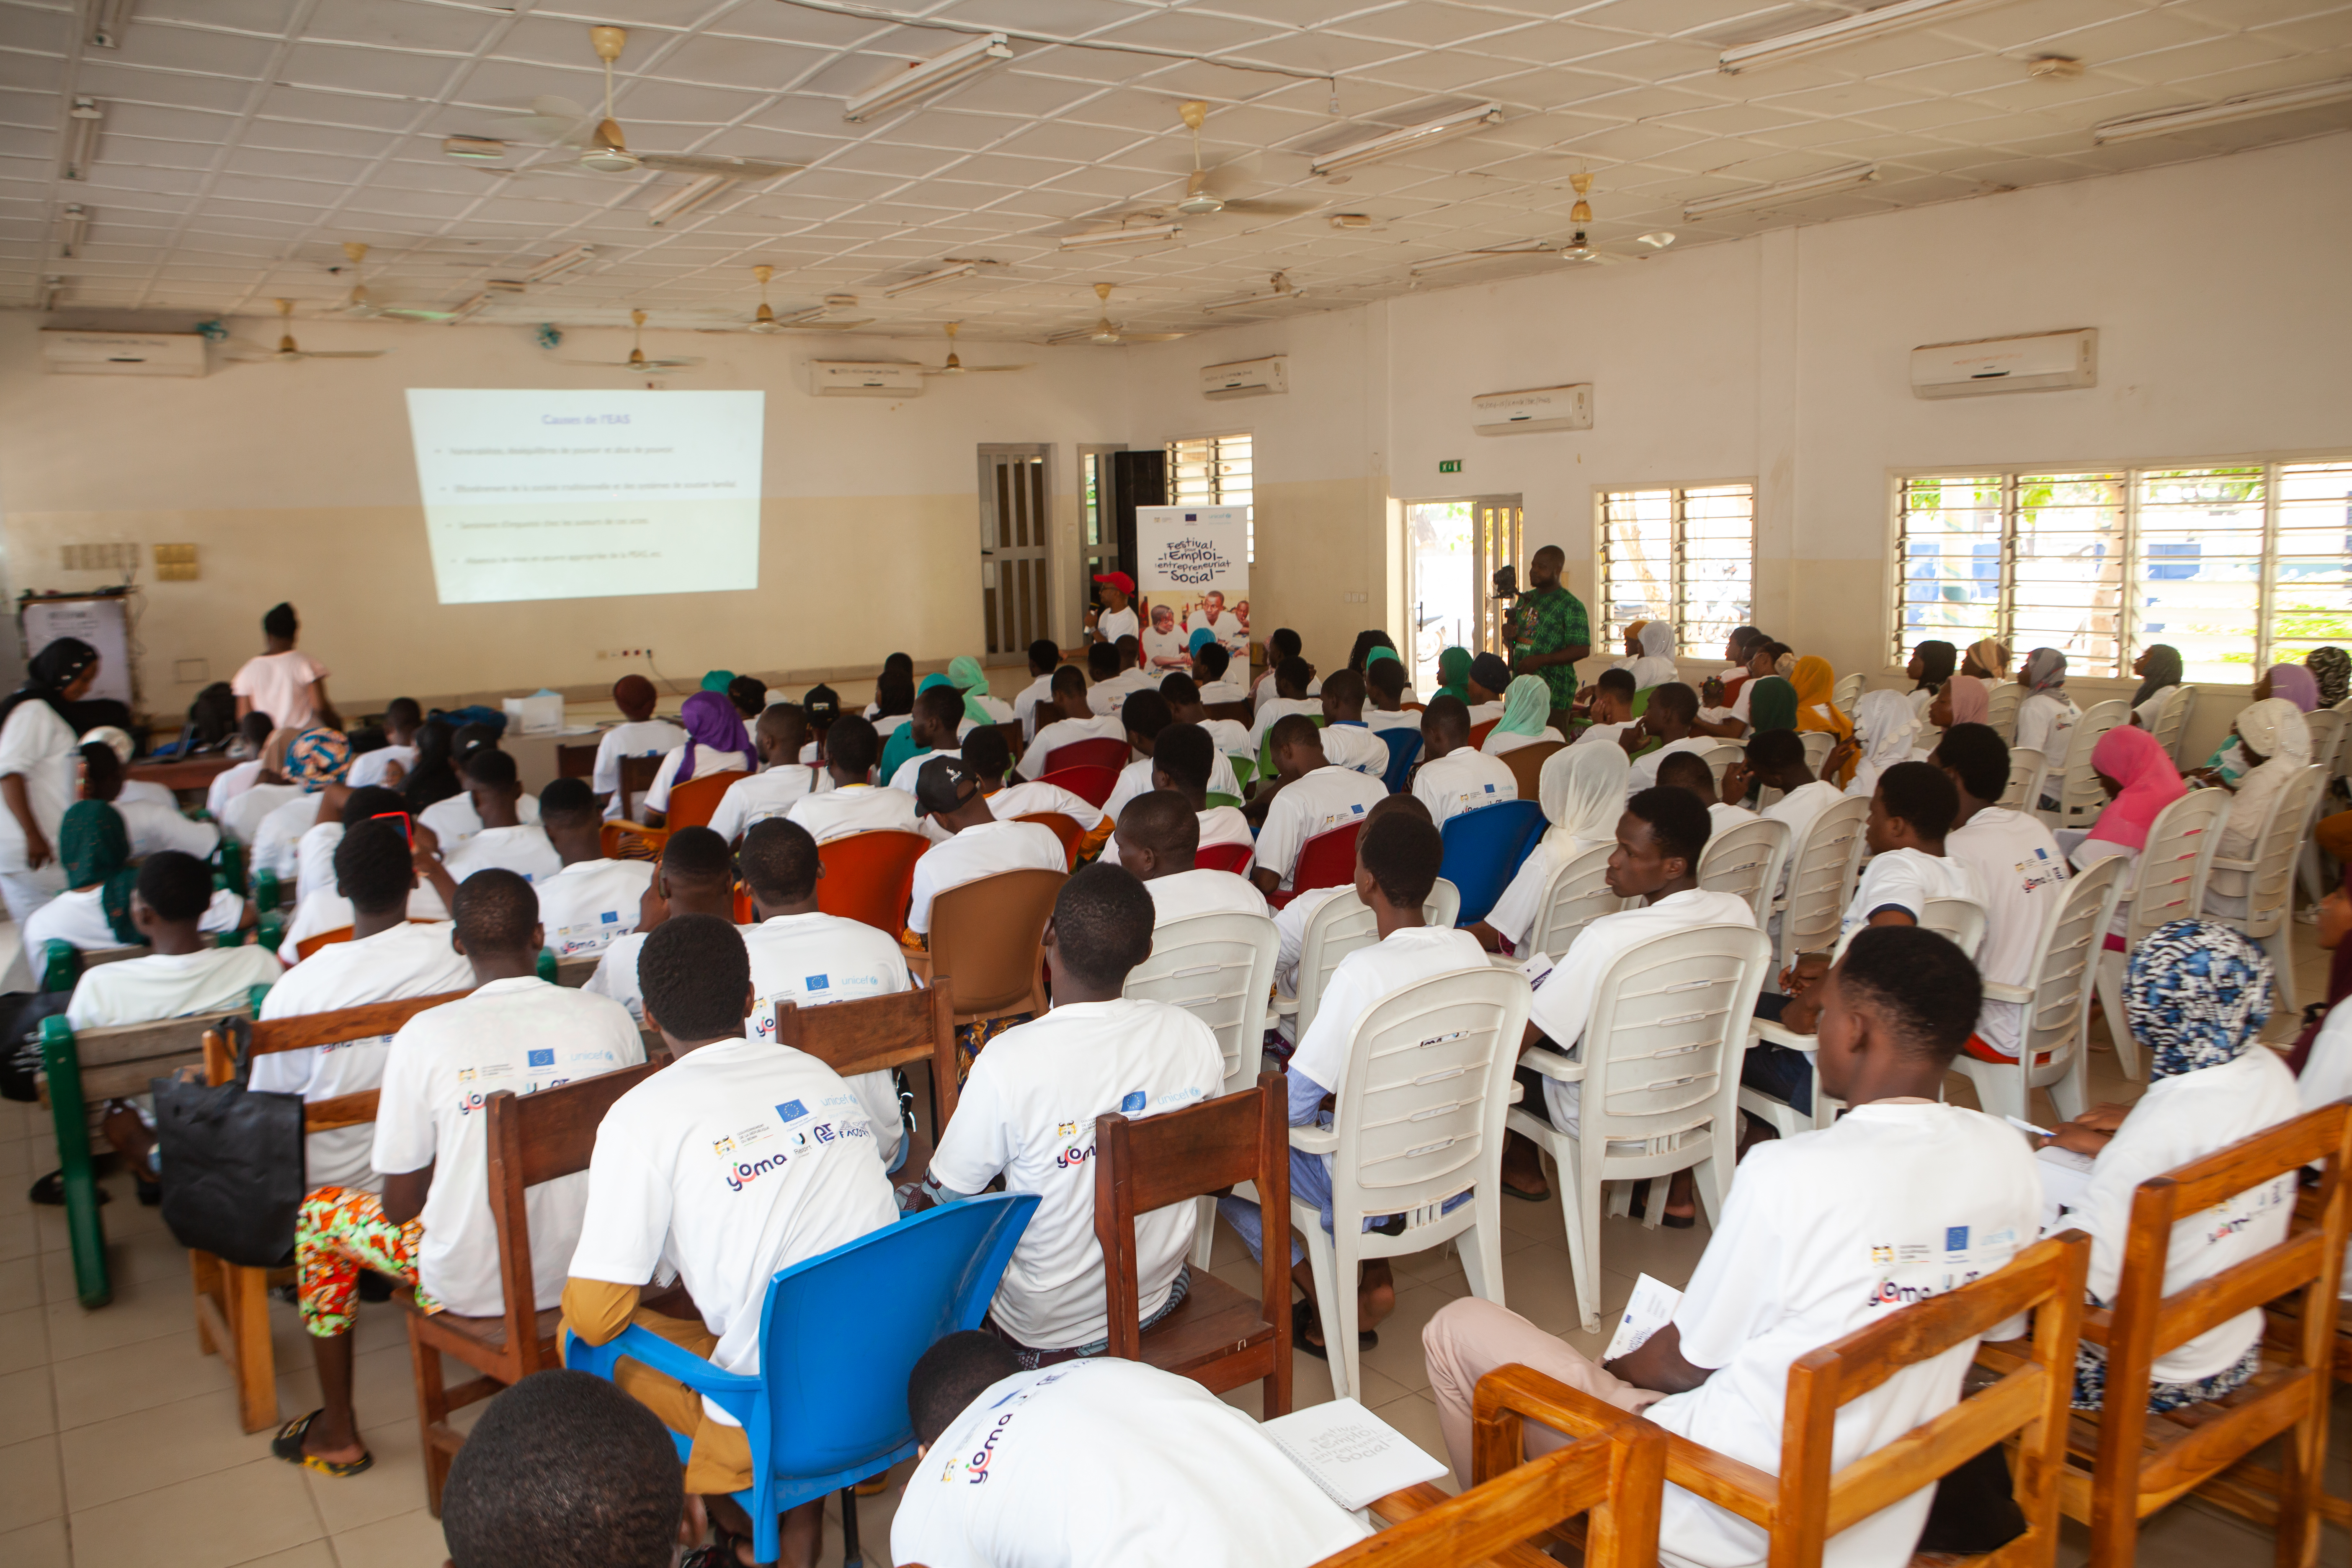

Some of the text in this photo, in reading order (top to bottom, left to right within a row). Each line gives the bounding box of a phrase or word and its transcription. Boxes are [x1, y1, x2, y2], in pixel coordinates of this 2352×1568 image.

[585, 415, 597, 424] de
[1167, 537, 1212, 550] Festival
[1171, 568, 1213, 584] Social
[842, 975, 869, 985] unicef
[756, 1016, 776, 1037] yo
[571, 1050, 603, 1061] unicef
[459, 1091, 485, 1115] yo
[820, 1094, 849, 1106] unicef
[1158, 1088, 1190, 1106] unicef
[1057, 1145, 1096, 1168] yom
[726, 1154, 788, 1191] yoma
[965, 1413, 1014, 1485] yoma
[1336, 1440, 1391, 1462] Social
